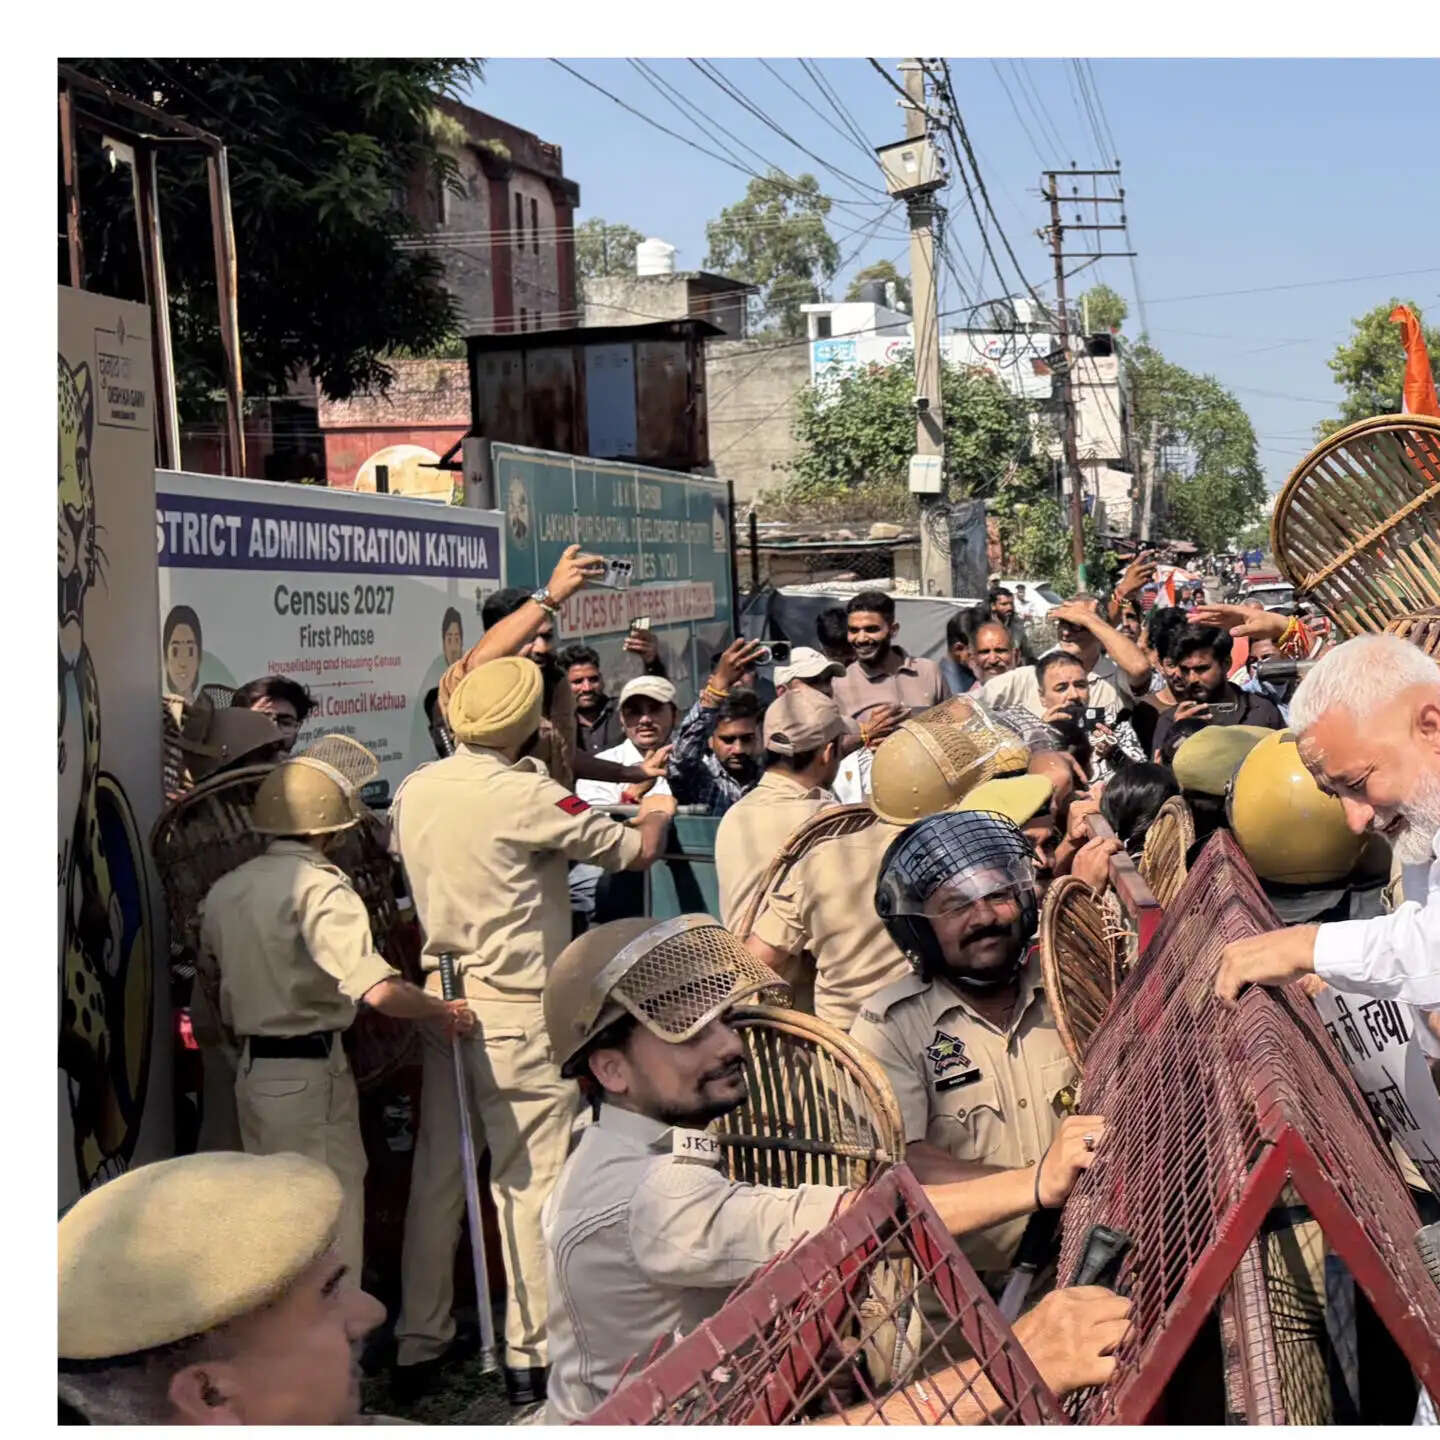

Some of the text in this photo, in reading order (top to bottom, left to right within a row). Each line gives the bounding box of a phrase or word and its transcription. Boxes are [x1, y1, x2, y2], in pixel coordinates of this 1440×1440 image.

[248, 517, 420, 567] ADMINISTRATION
[425, 532, 489, 570] KATHUA
[274, 584, 394, 616] Census 2027
[560, 593, 608, 633] PLACES
[608, 591, 626, 627] OF
[300, 625, 374, 648] First Phase
[323, 657, 340, 671] and
[341, 656, 373, 672] Housing
[327, 692, 367, 717] Council
[369, 690, 407, 712] Kathua
